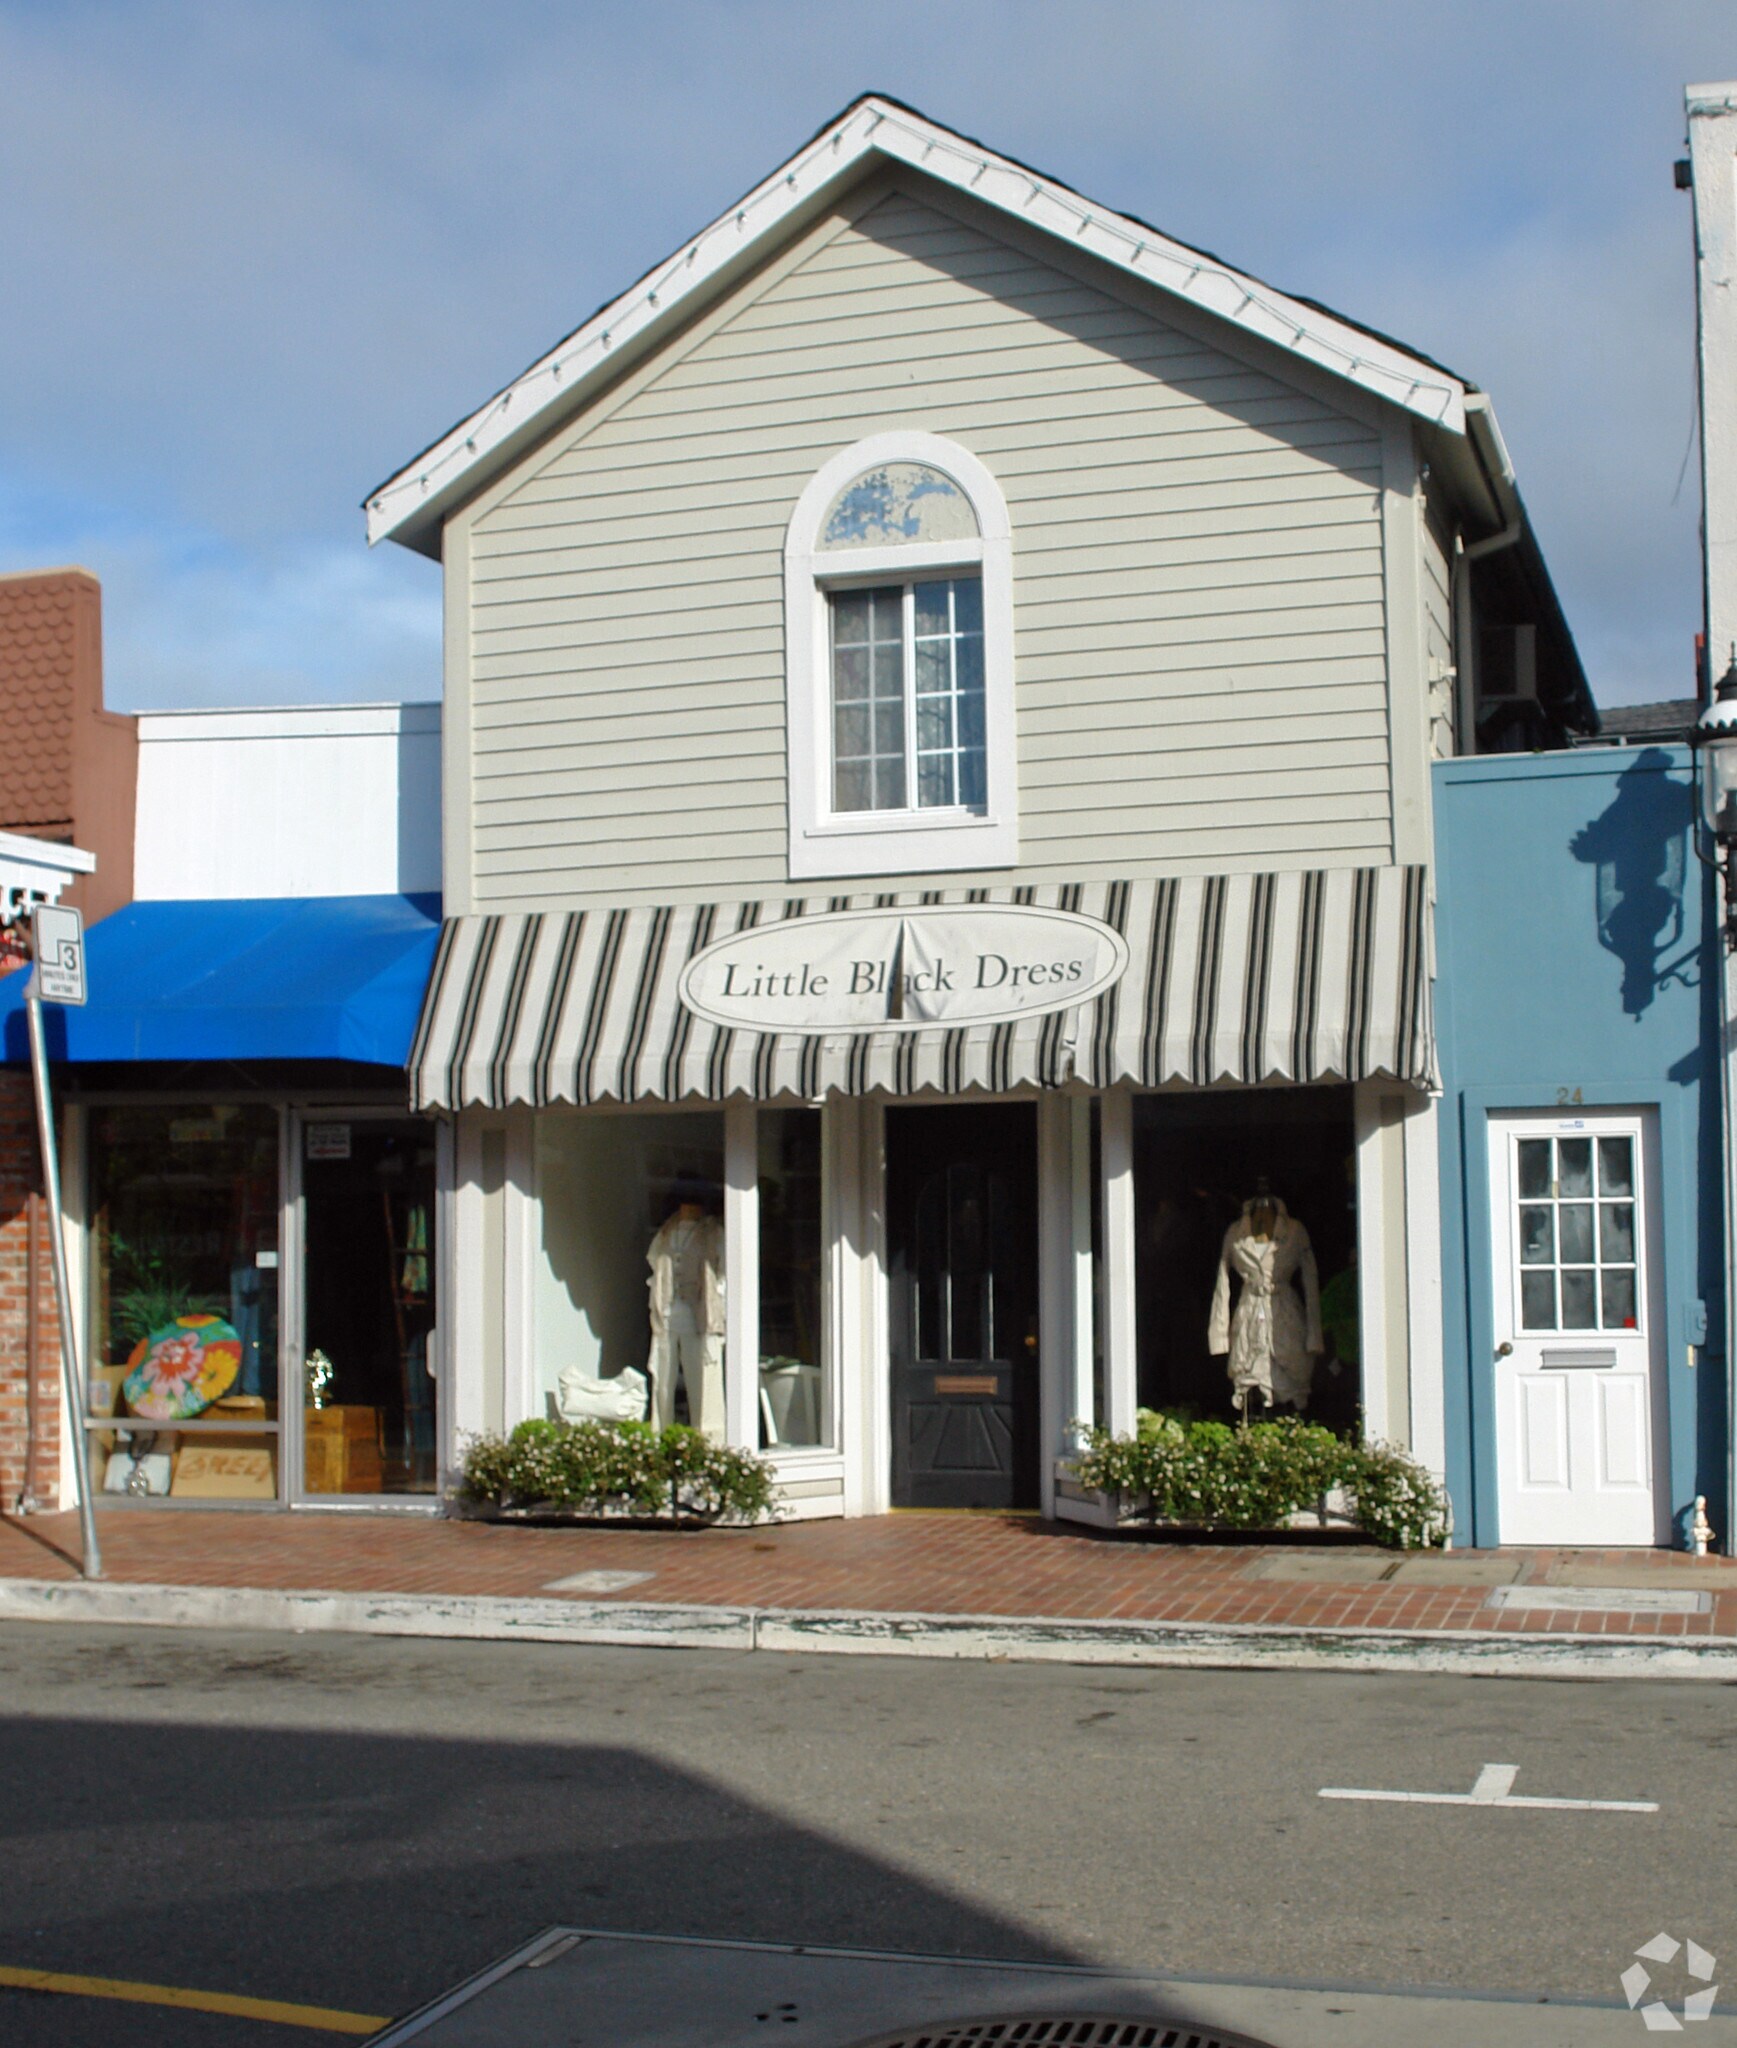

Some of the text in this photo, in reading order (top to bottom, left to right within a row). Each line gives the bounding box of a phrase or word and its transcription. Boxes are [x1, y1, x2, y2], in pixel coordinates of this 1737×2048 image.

[63, 945, 77, 971] 3
[720, 963, 829, 997] Little
[973, 953, 1083, 990] Dress
[1556, 1087, 1583, 1105] 24
